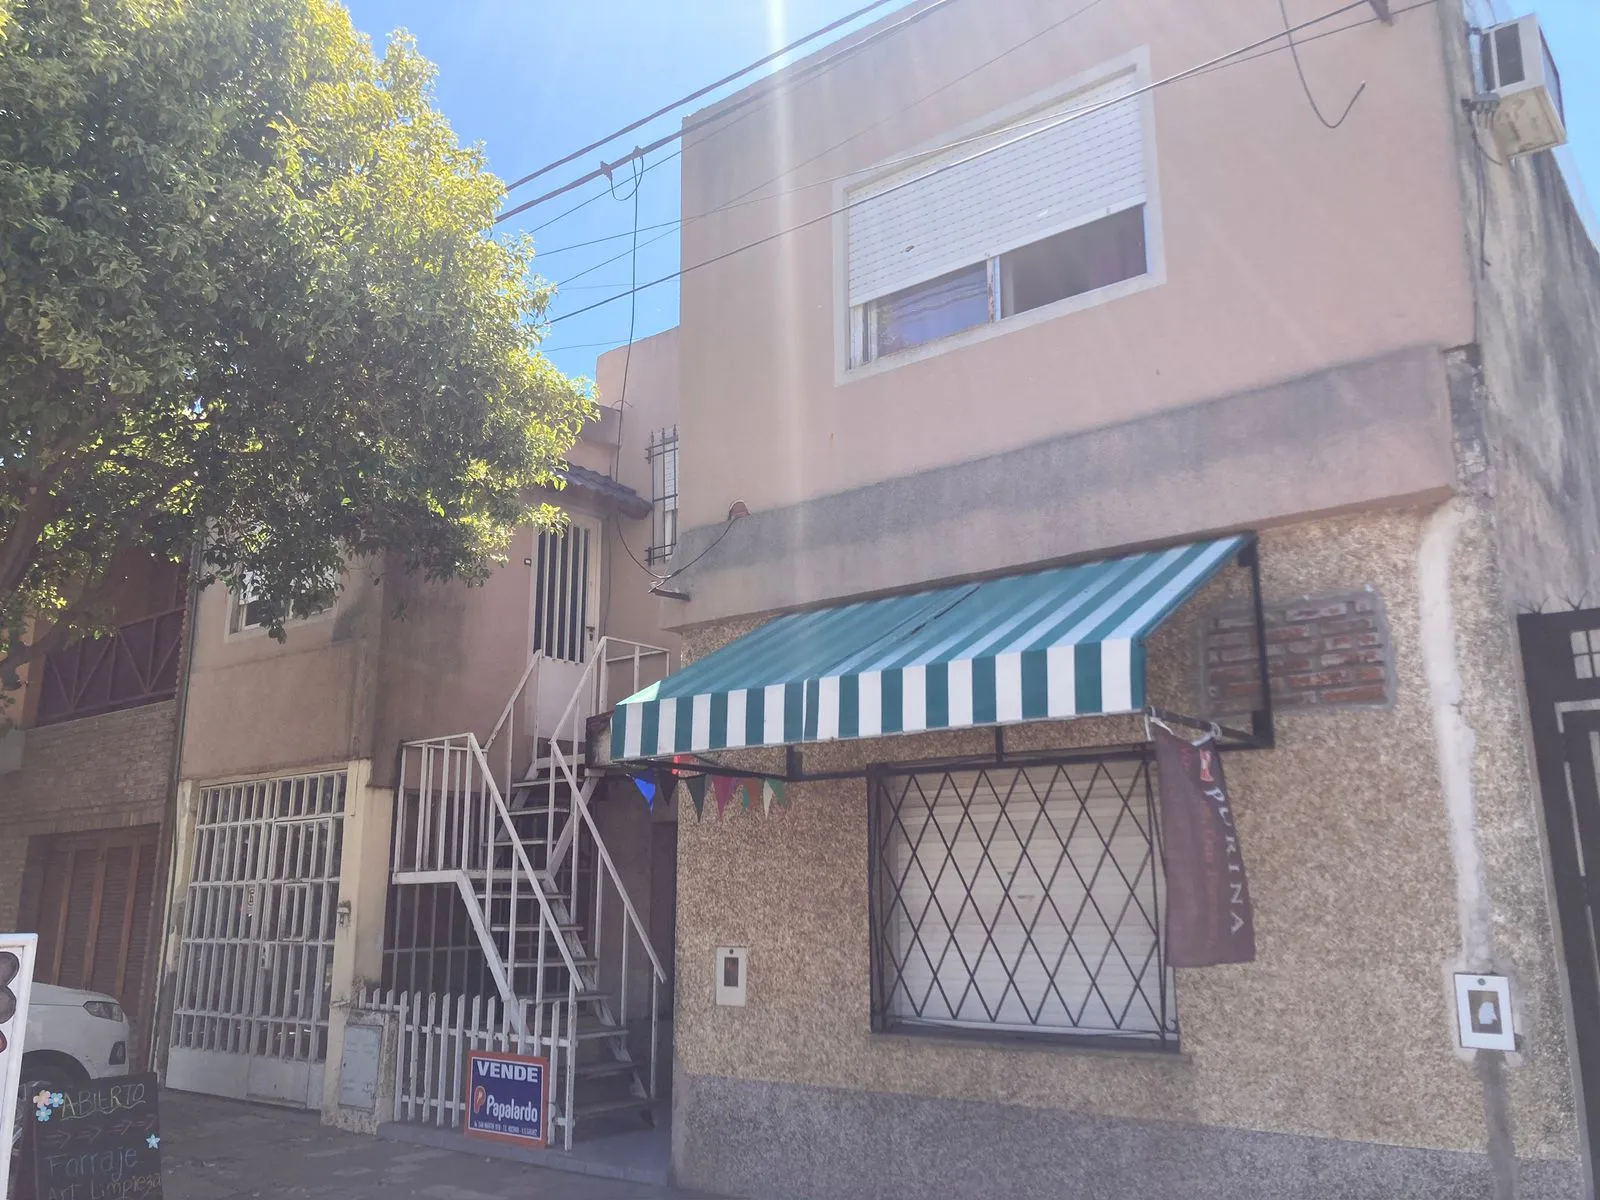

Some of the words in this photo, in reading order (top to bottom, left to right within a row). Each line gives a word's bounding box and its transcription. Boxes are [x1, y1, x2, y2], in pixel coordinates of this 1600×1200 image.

[1203, 786, 1245, 936] PURINA
[476, 1060, 539, 1083] VENDE
[486, 1094, 538, 1123] Papalardo
[45, 1146, 138, 1180] Forraje
